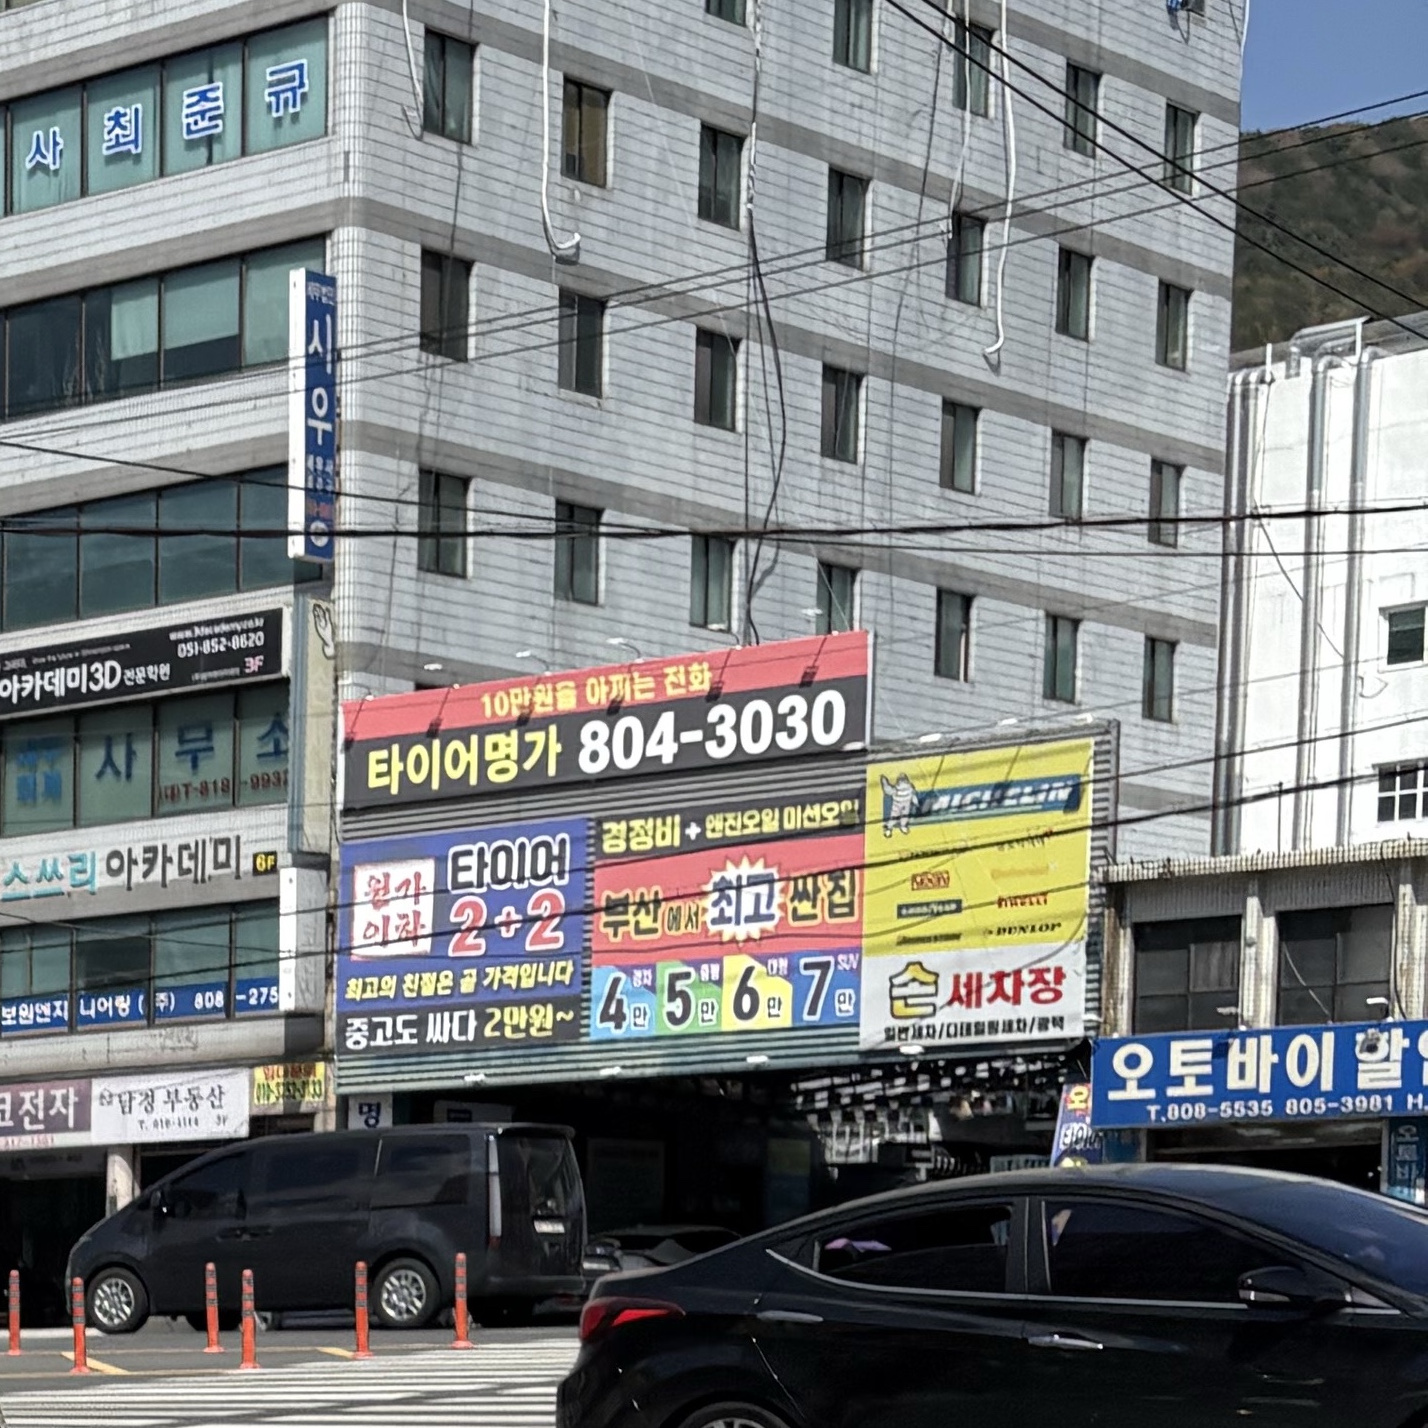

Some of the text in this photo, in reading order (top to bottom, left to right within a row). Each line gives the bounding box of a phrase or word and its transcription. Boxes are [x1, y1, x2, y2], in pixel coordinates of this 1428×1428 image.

[481, 680, 577, 718] 10만원을
[663, 661, 713, 697] 전화
[367, 689, 846, 796] 타이어명가 804-3030
[601, 813, 681, 854] 경정비
[705, 808, 780, 839] 엔진오일
[105, 834, 242, 892] 아카데미
[449, 833, 570, 893] 타이어
[709, 872, 777, 928] 최고
[482, 959, 574, 991] 가격입니다
[947, 966, 1067, 1010] 세차장
[345, 1014, 419, 1050] 중고도
[426, 1009, 478, 1044] 싸다
[1108, 1028, 1428, 1101] 오토바이 할
